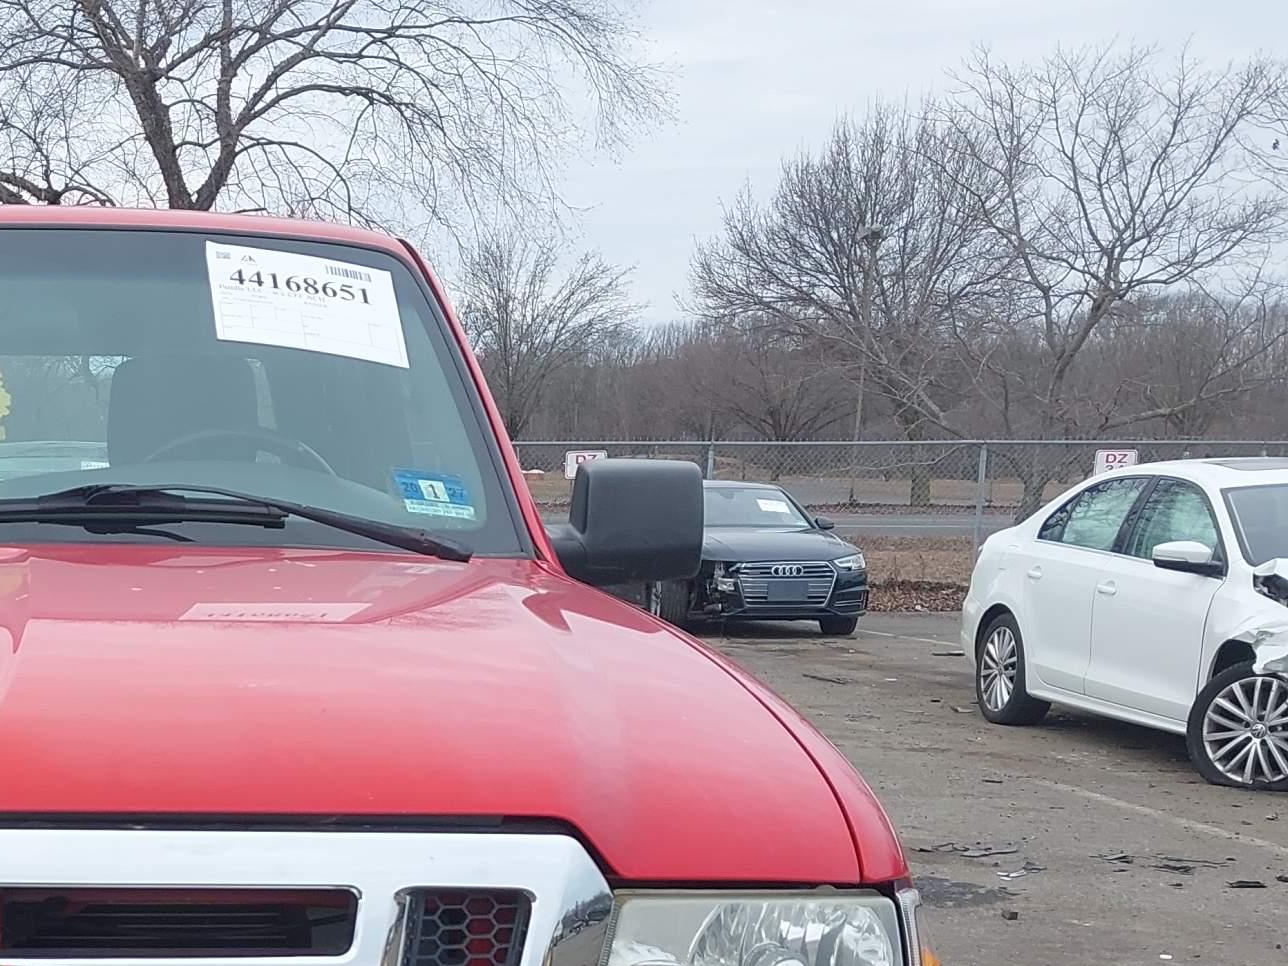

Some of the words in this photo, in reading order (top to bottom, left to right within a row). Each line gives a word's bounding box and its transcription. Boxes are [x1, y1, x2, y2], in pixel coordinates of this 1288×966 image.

[230, 268, 373, 305] 44168651
[1105, 453, 1129, 464] DZ
[428, 484, 441, 499] 1
